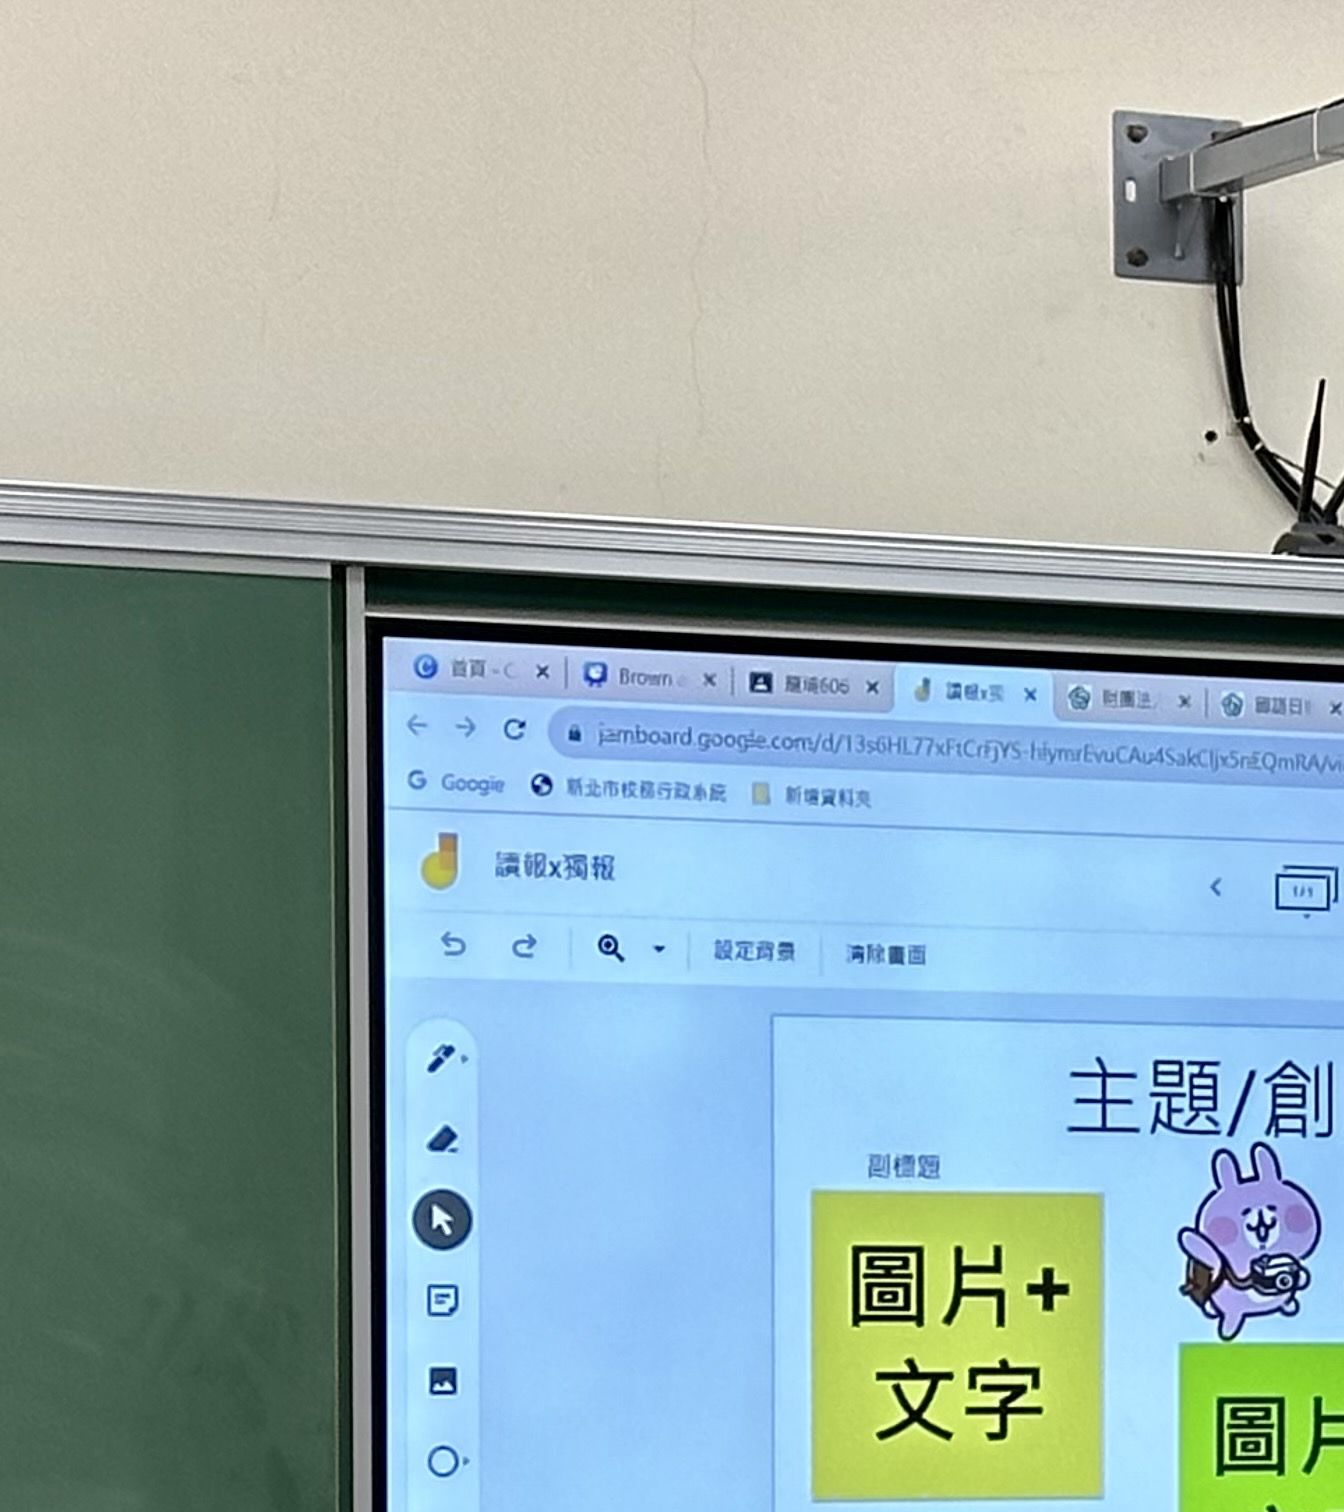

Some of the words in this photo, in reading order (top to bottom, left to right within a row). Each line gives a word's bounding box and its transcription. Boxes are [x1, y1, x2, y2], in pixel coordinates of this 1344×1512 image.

[619, 668, 672, 686] Brown
[441, 773, 505, 796] Google
[714, 940, 796, 962] 設定背景
[867, 1153, 941, 1179] 副標題
[851, 1245, 1070, 1328] 圖片+
[875, 1358, 1043, 1441] 文字
